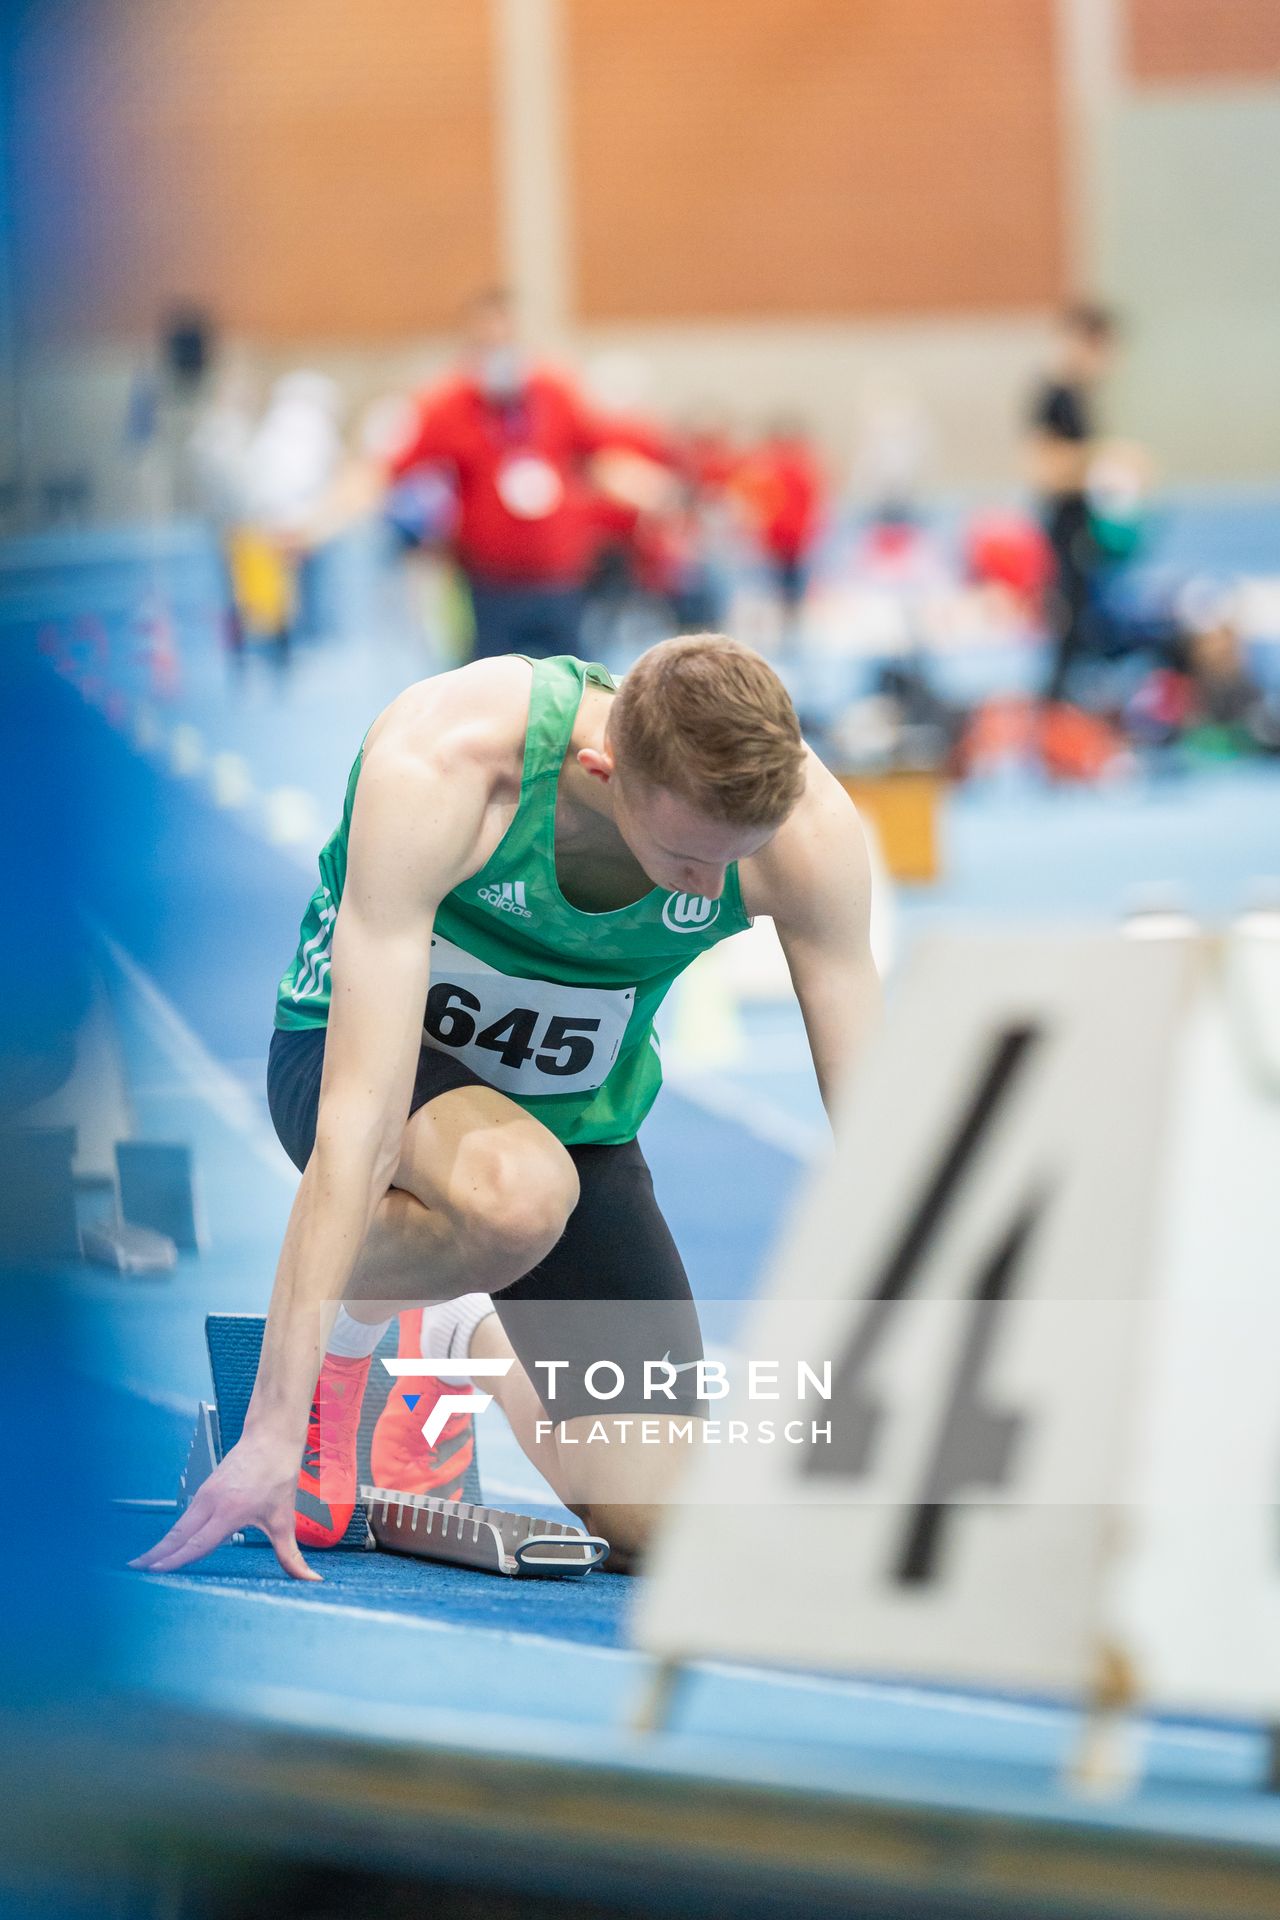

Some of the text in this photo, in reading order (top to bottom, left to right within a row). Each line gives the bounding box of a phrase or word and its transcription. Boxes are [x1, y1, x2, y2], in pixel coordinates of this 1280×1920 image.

[477, 886, 532, 919] adidas
[423, 982, 601, 1076] 645
[796, 1016, 1046, 1590] 4
